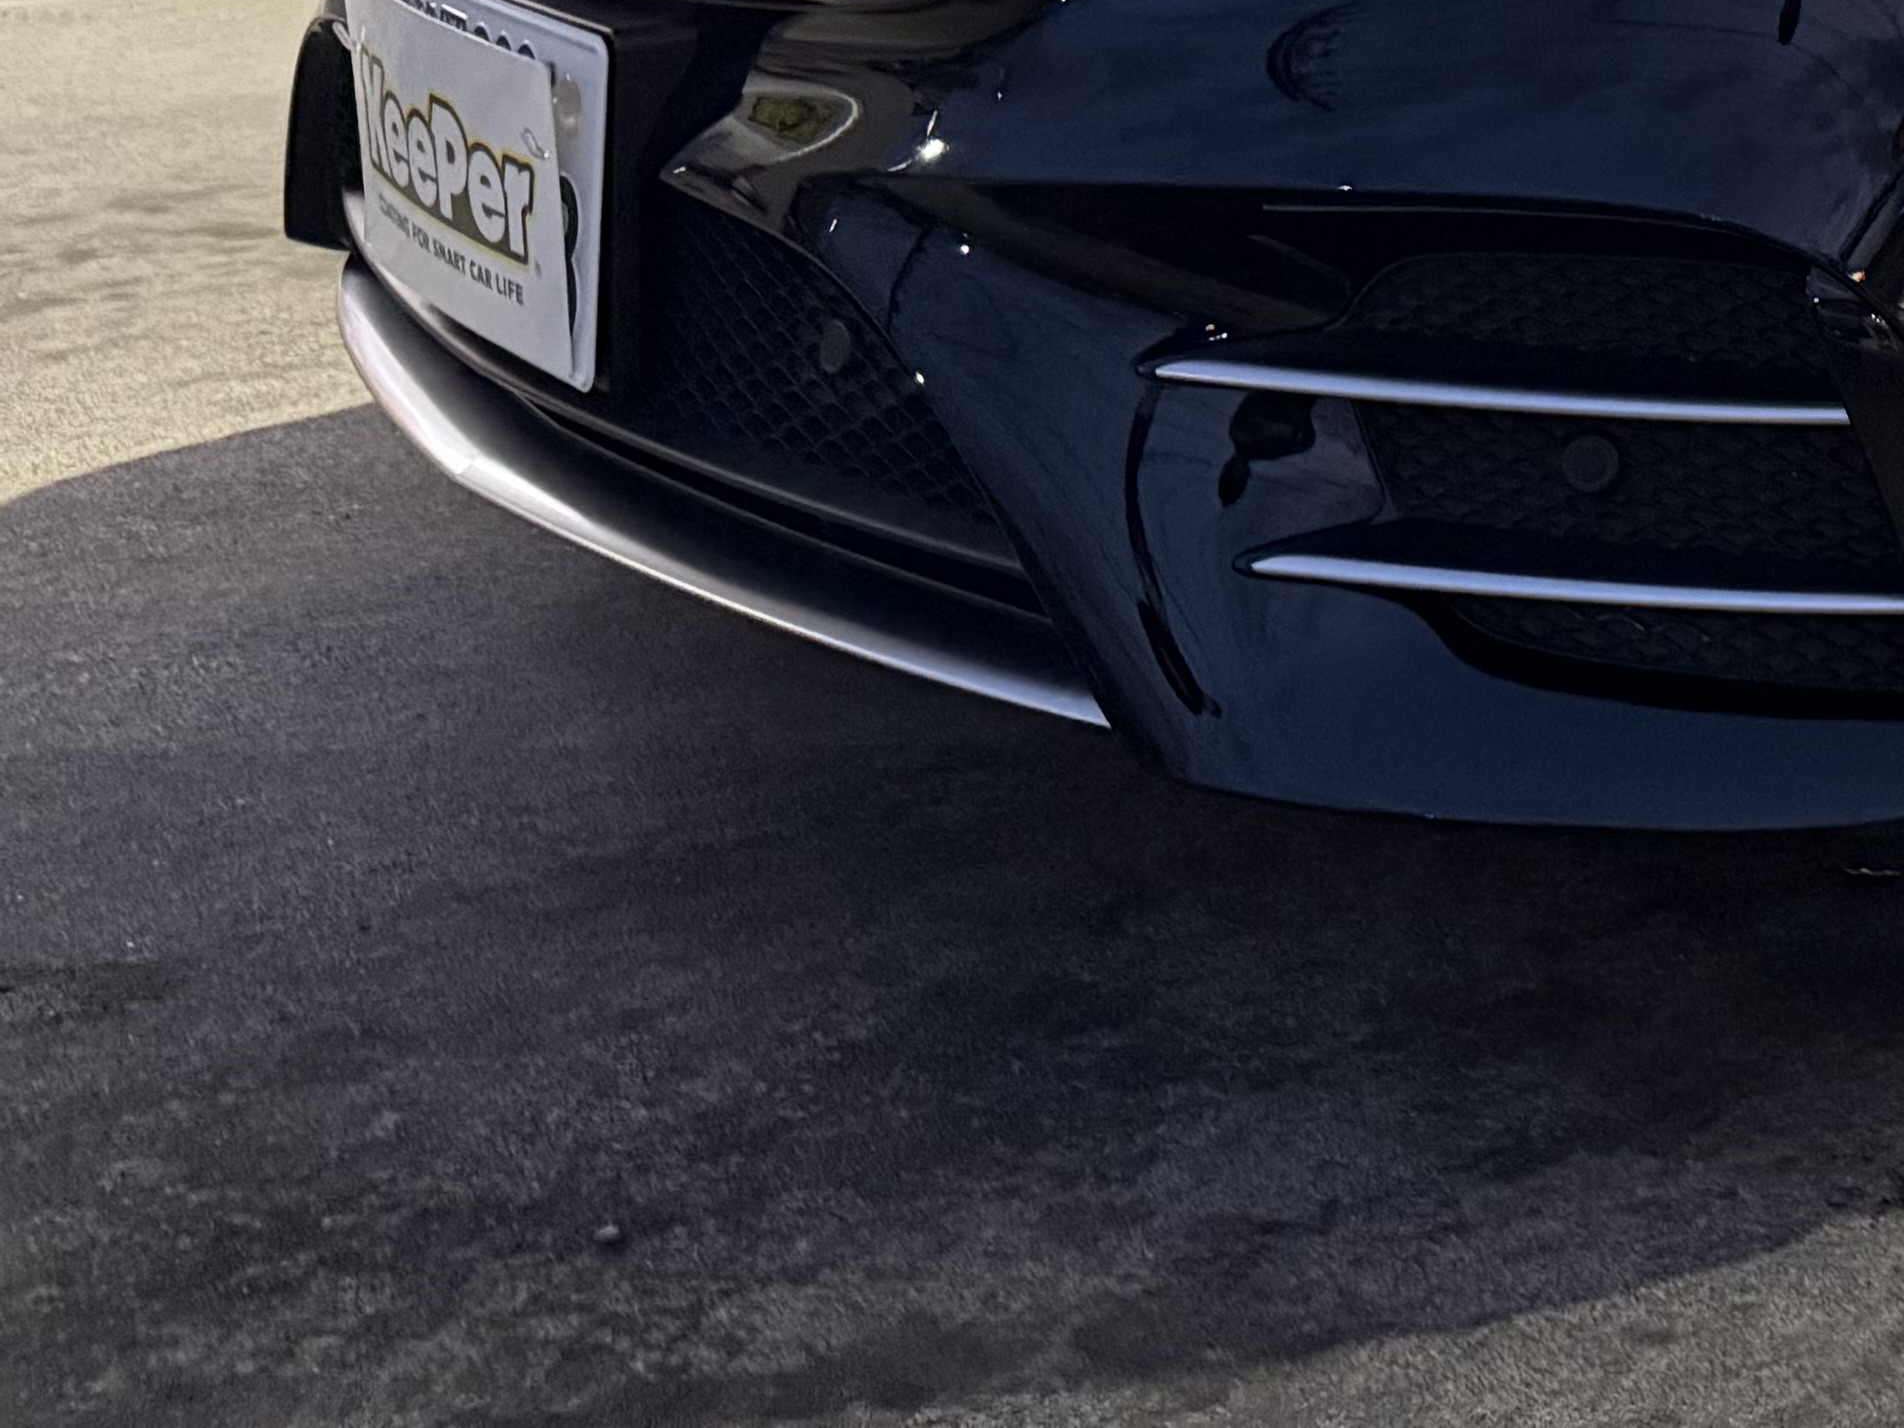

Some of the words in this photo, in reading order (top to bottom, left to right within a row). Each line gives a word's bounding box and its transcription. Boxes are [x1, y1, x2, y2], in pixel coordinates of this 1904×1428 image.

[361, 44, 534, 265] KeePer
[469, 260, 492, 290] CAR
[495, 274, 525, 307] LIFE
